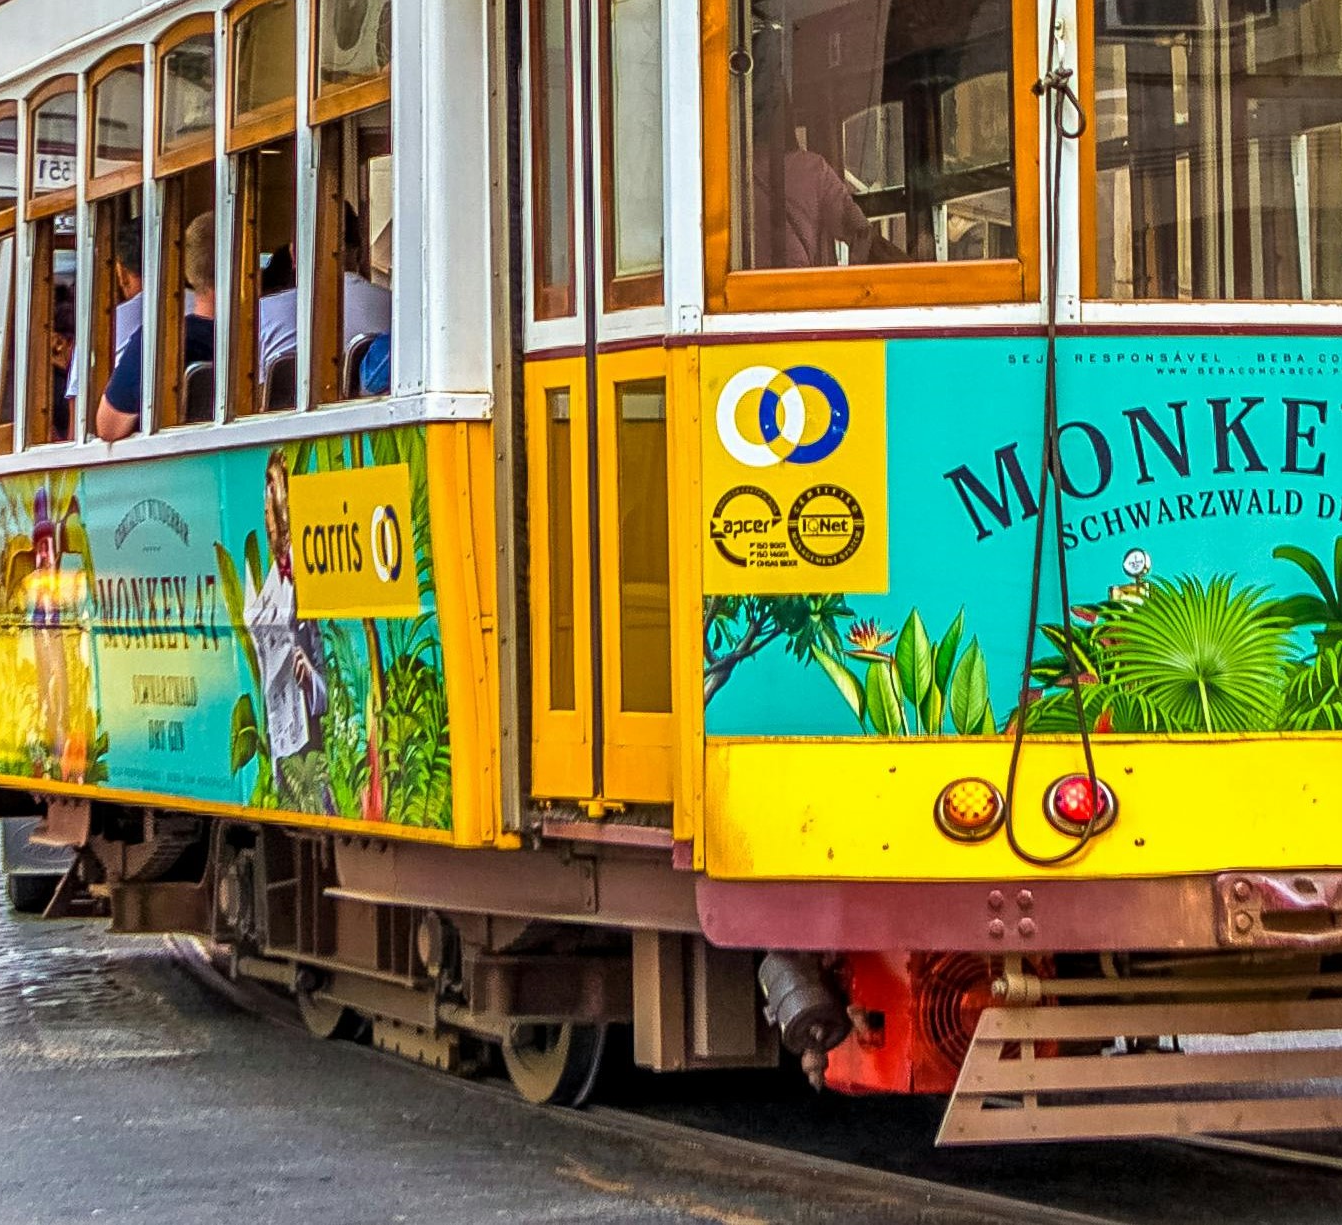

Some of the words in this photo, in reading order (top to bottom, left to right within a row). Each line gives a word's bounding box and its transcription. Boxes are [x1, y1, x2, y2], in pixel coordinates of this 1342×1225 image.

[1008, 353, 1058, 365] SEJ
[1074, 350, 1222, 364] RESPONSÁVEL
[1257, 353, 1306, 364] BEBA
[302, 500, 363, 575] carris
[723, 518, 771, 540] apcer
[802, 517, 849, 534] IQNet
[1061, 489, 1305, 550] SCHWARZWALD
[98, 576, 190, 650] MONKEY
[193, 574, 220, 652] 47
